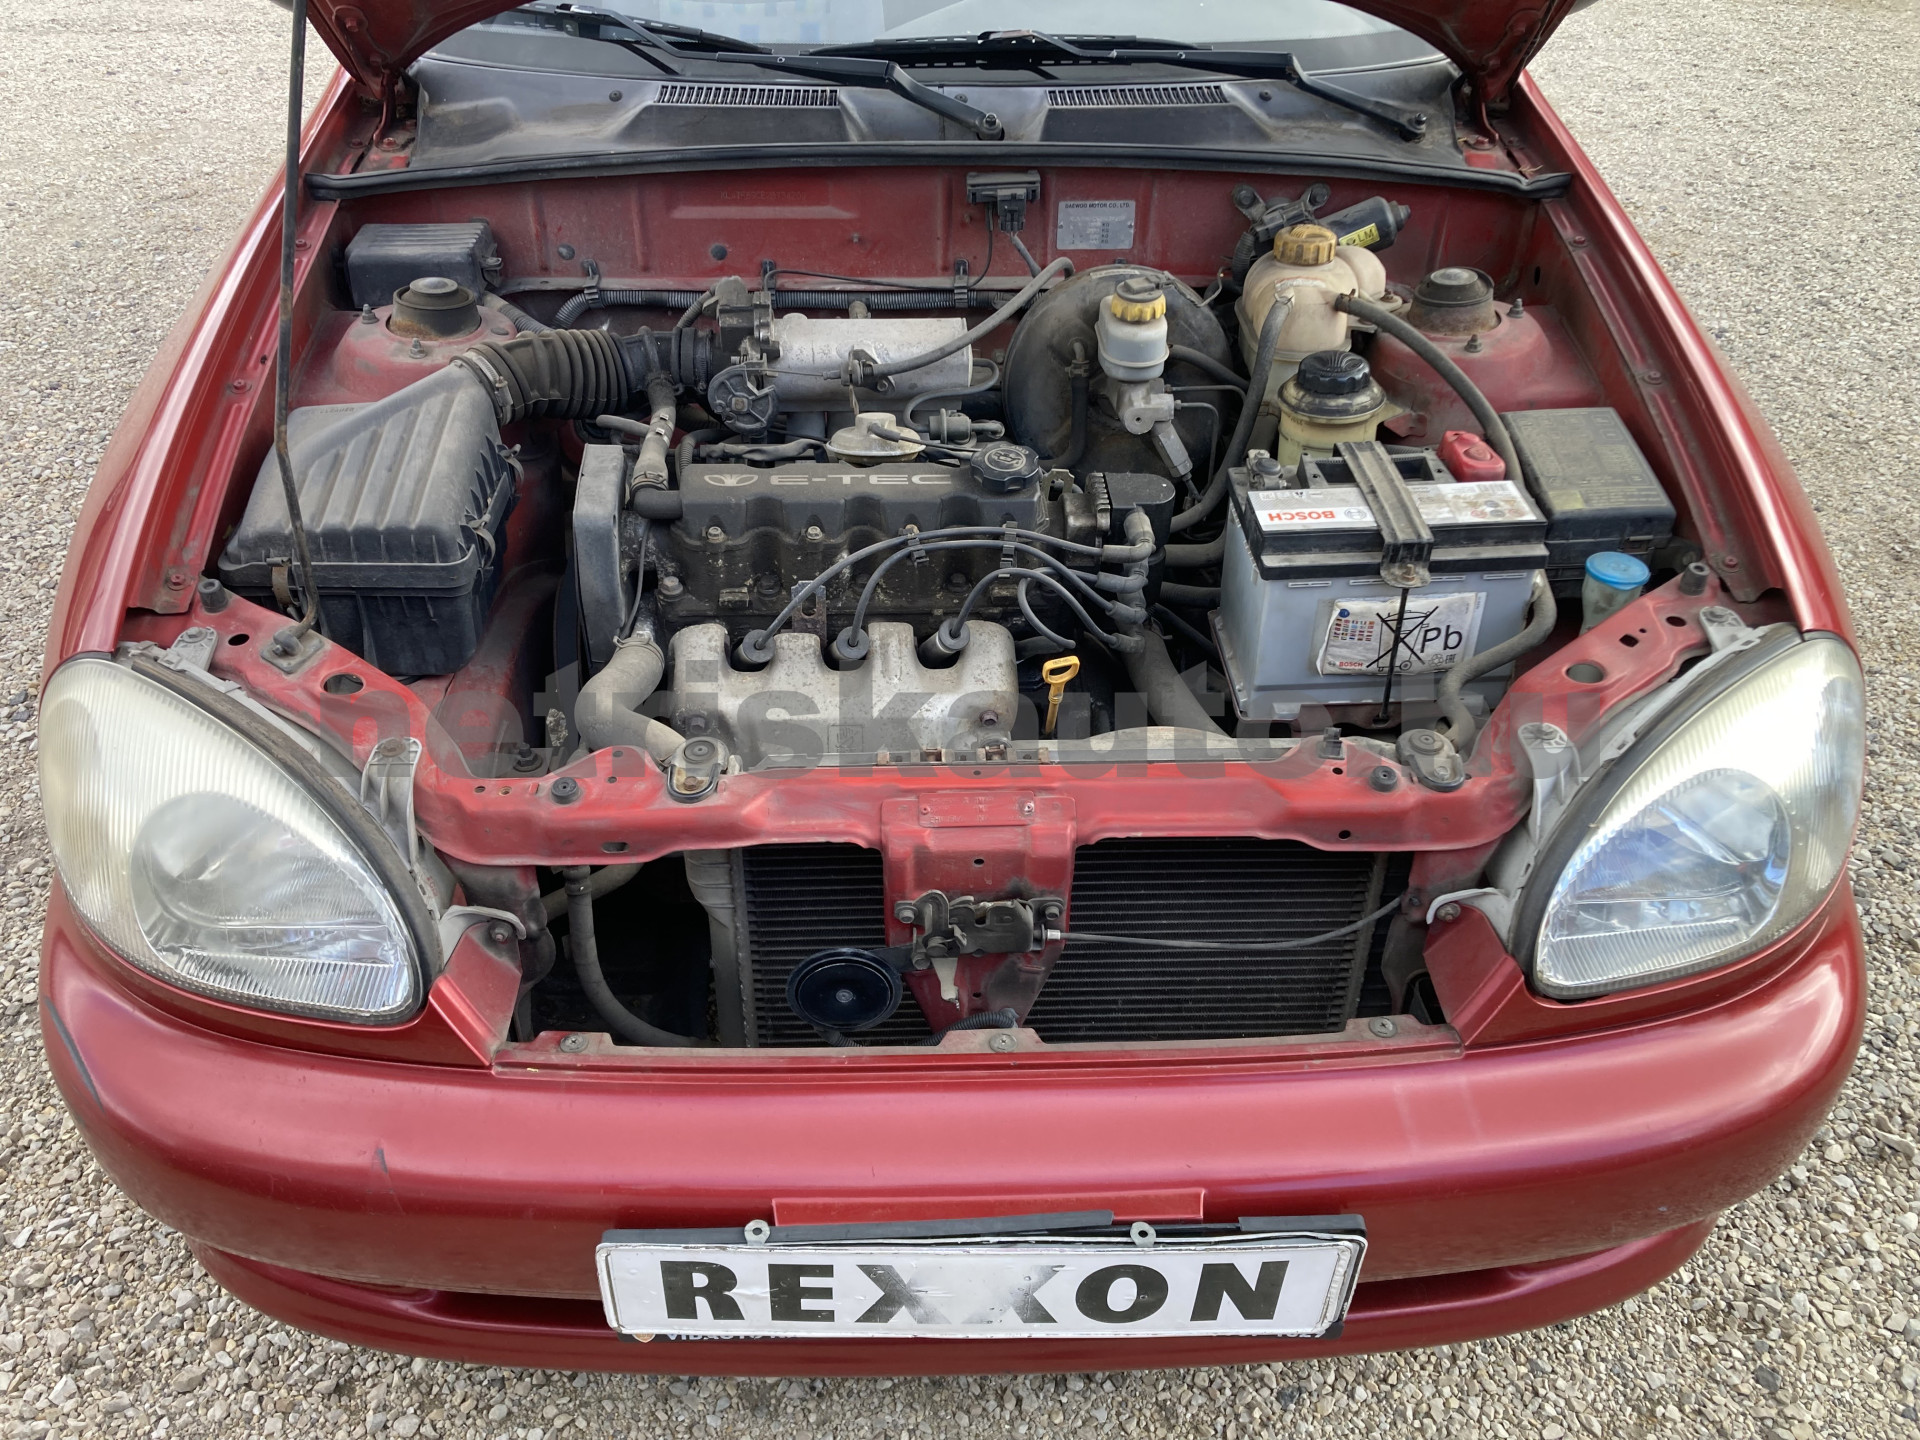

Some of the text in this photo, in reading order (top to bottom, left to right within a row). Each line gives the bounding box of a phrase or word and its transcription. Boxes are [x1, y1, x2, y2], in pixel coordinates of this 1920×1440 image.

[770, 474, 952, 486] E-TEC
[1267, 510, 1337, 522] BOSCH
[1420, 624, 1463, 654] Pb
[1338, 661, 1364, 669] BOSCH
[659, 1260, 1290, 1325] REXXON
